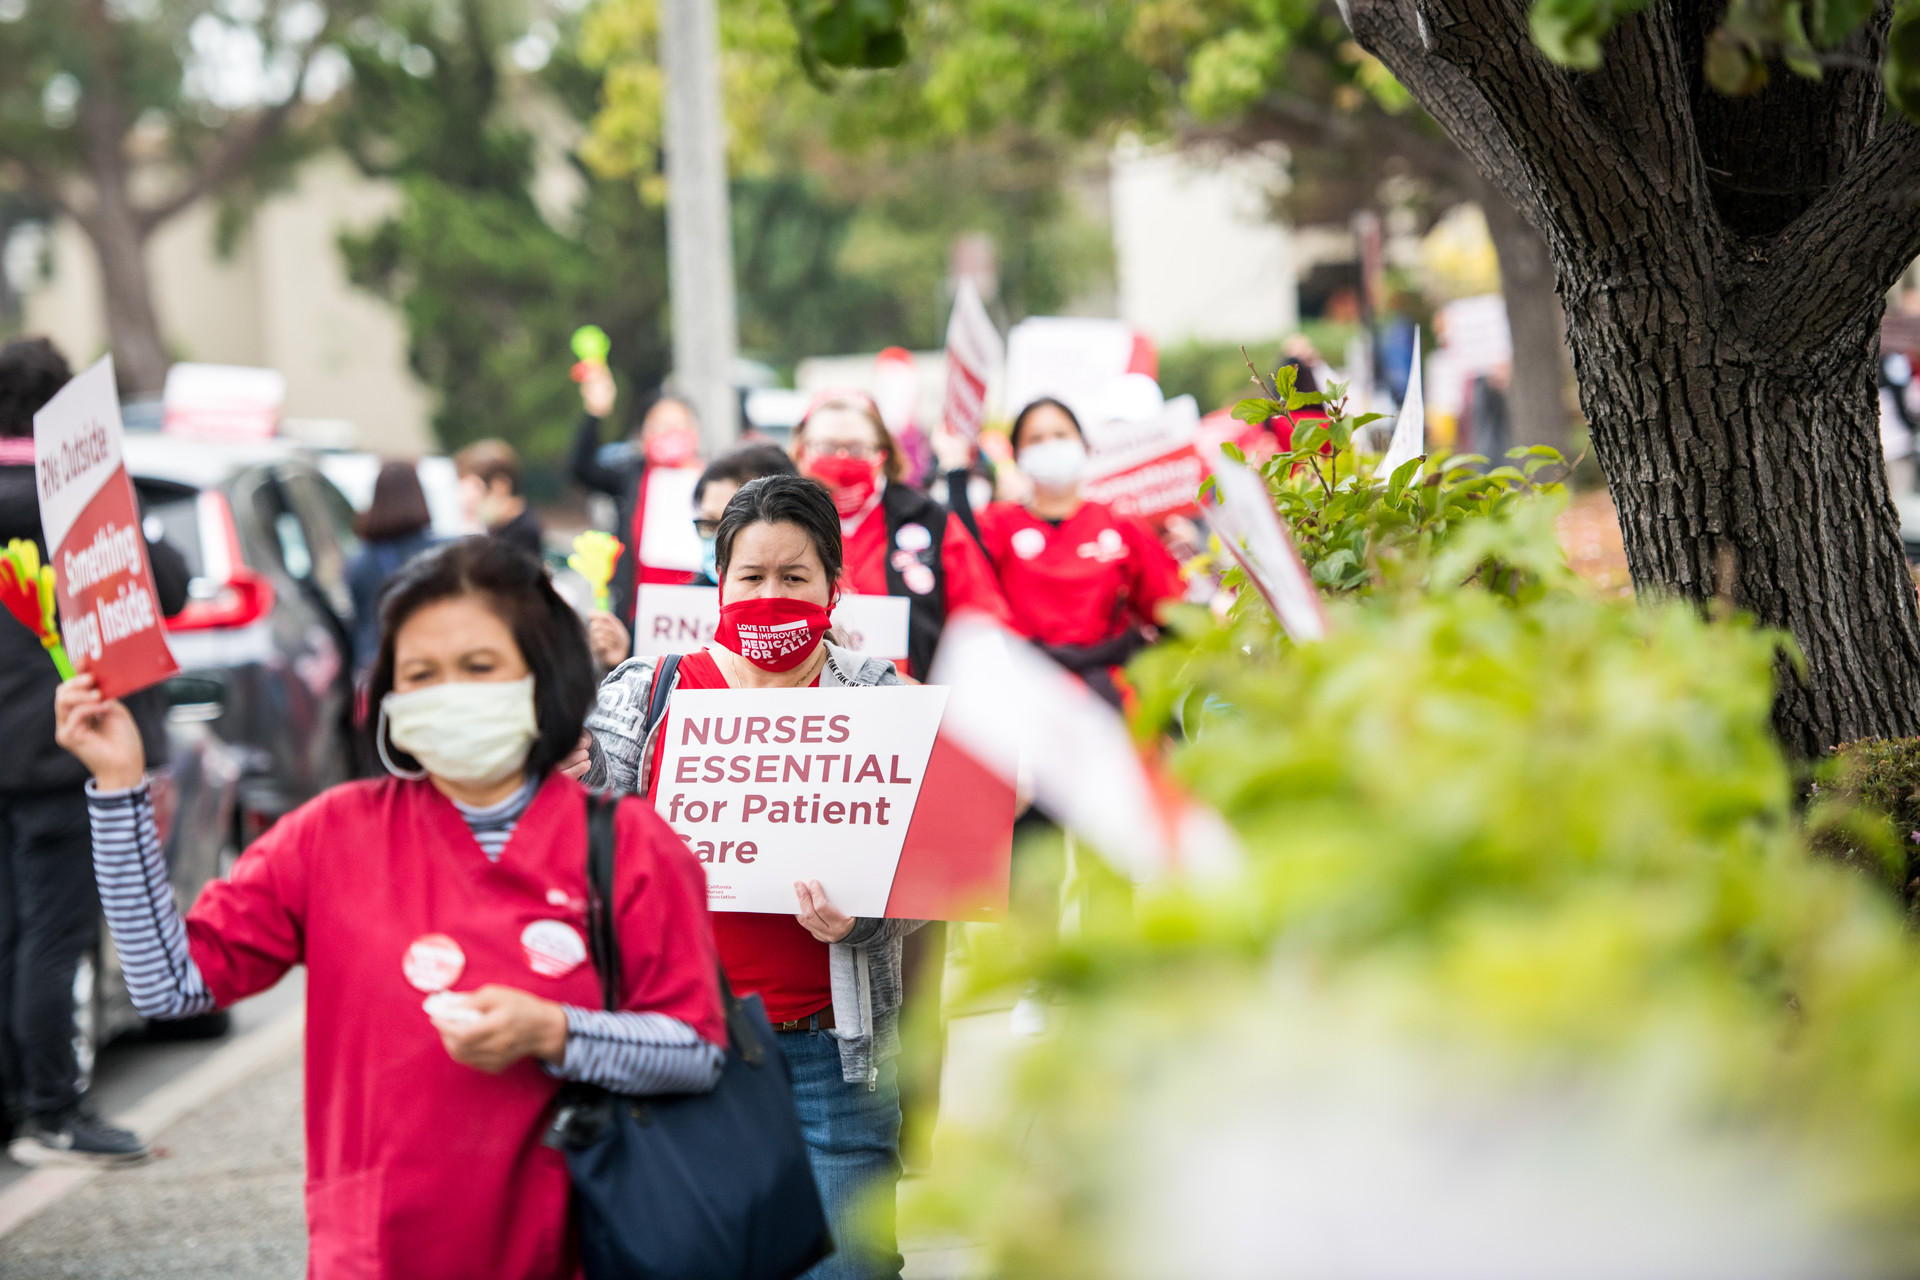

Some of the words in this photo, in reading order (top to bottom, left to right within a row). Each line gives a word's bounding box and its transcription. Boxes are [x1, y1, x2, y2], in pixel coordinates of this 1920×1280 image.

[61, 417, 107, 484] Outside
[64, 521, 141, 597] Something
[96, 579, 154, 645] Inside
[653, 615, 715, 642] RNs
[737, 623, 757, 632] LOVE
[759, 630, 796, 640] IMPROVE
[798, 628, 809, 637] IT!
[741, 648, 773, 660] FOR
[780, 634, 811, 656] ALL!
[681, 714, 850, 745] NURSES
[675, 754, 912, 784] ESSENTIAL
[669, 793, 727, 822] for
[742, 793, 890, 825] Patient
[677, 834, 758, 863] are
